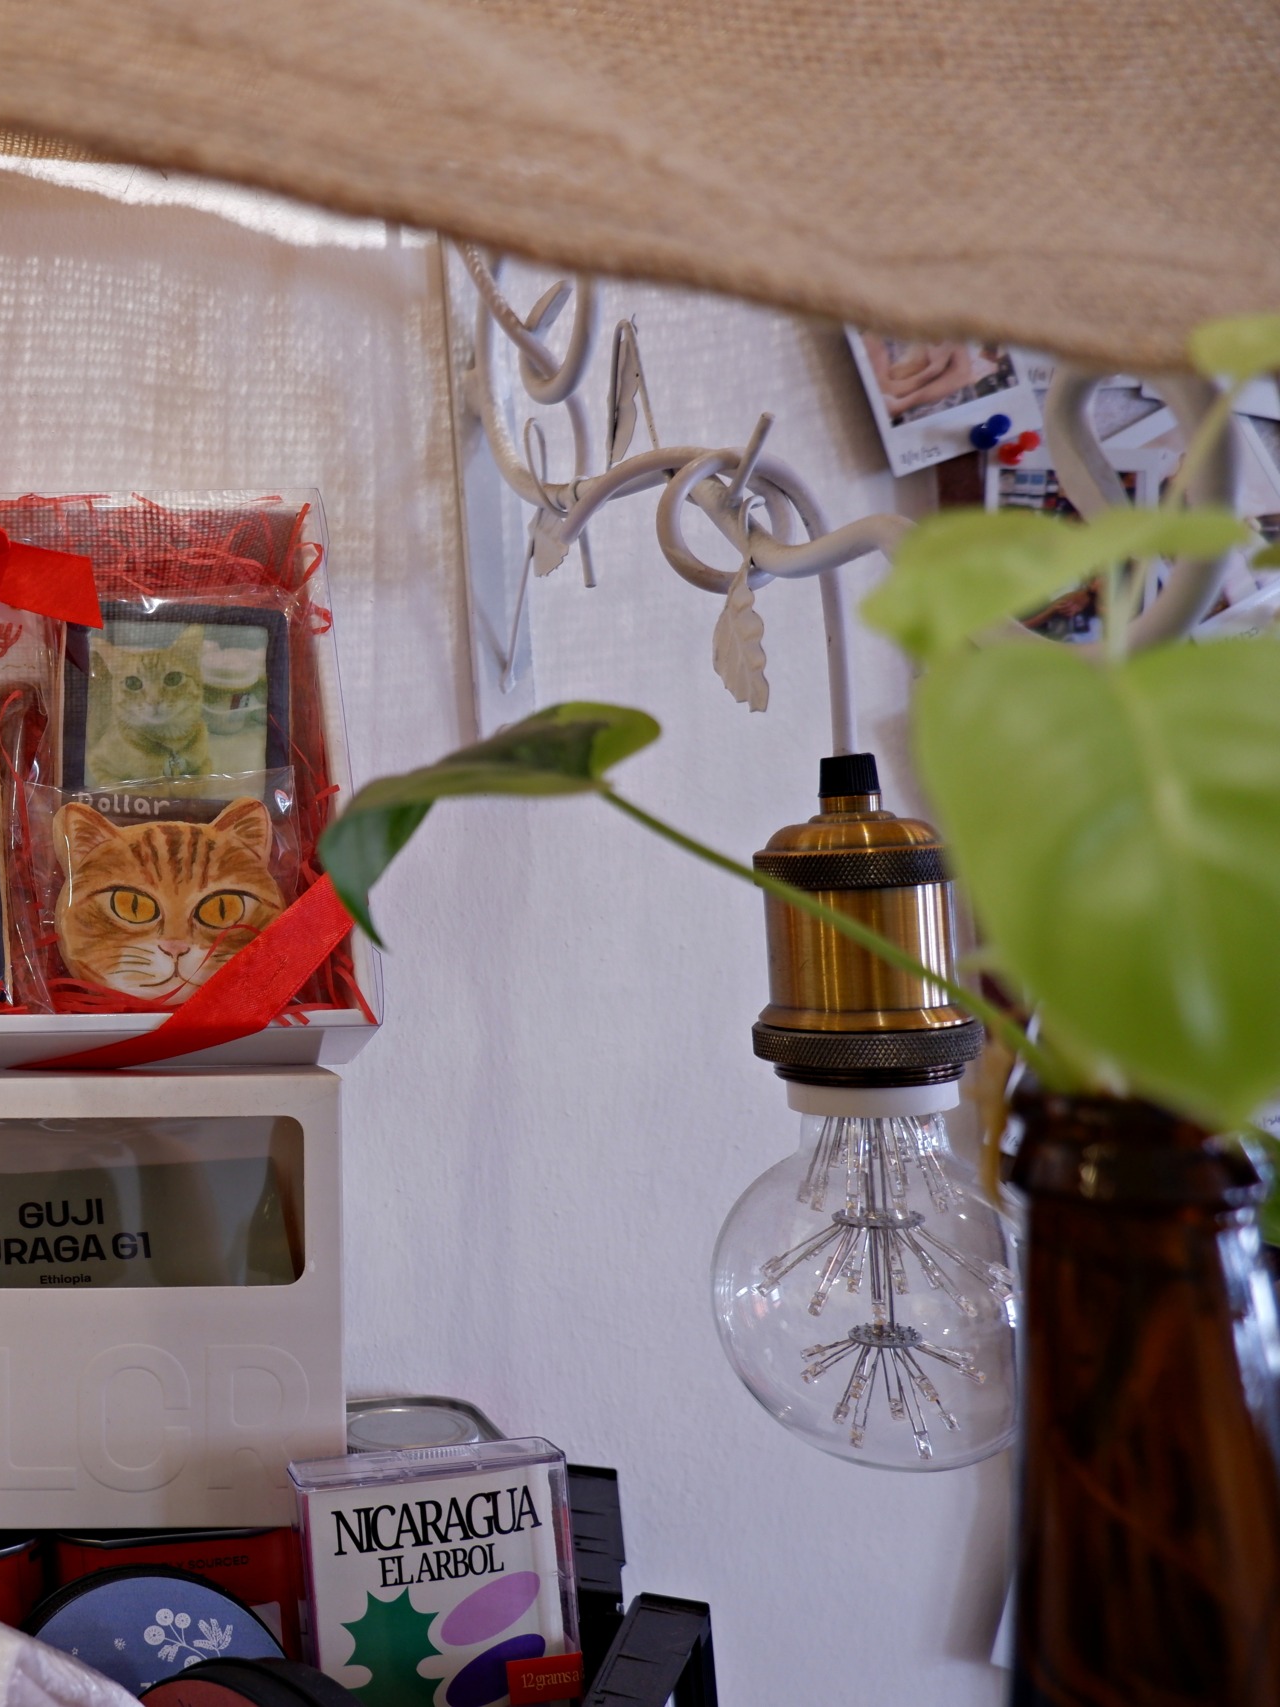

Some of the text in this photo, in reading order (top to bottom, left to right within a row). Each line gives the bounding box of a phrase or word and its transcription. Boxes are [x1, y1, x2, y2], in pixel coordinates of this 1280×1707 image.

[18, 1197, 106, 1229] GUJI
[111, 1231, 152, 1260] G1
[39, 1272, 92, 1286] Ethiopia
[331, 1485, 543, 1556] NICARAGUA
[189, 1555, 250, 1569] SOURCED
[379, 1542, 505, 1588] EL ARBOL
[535, 1670, 571, 1691] grams
